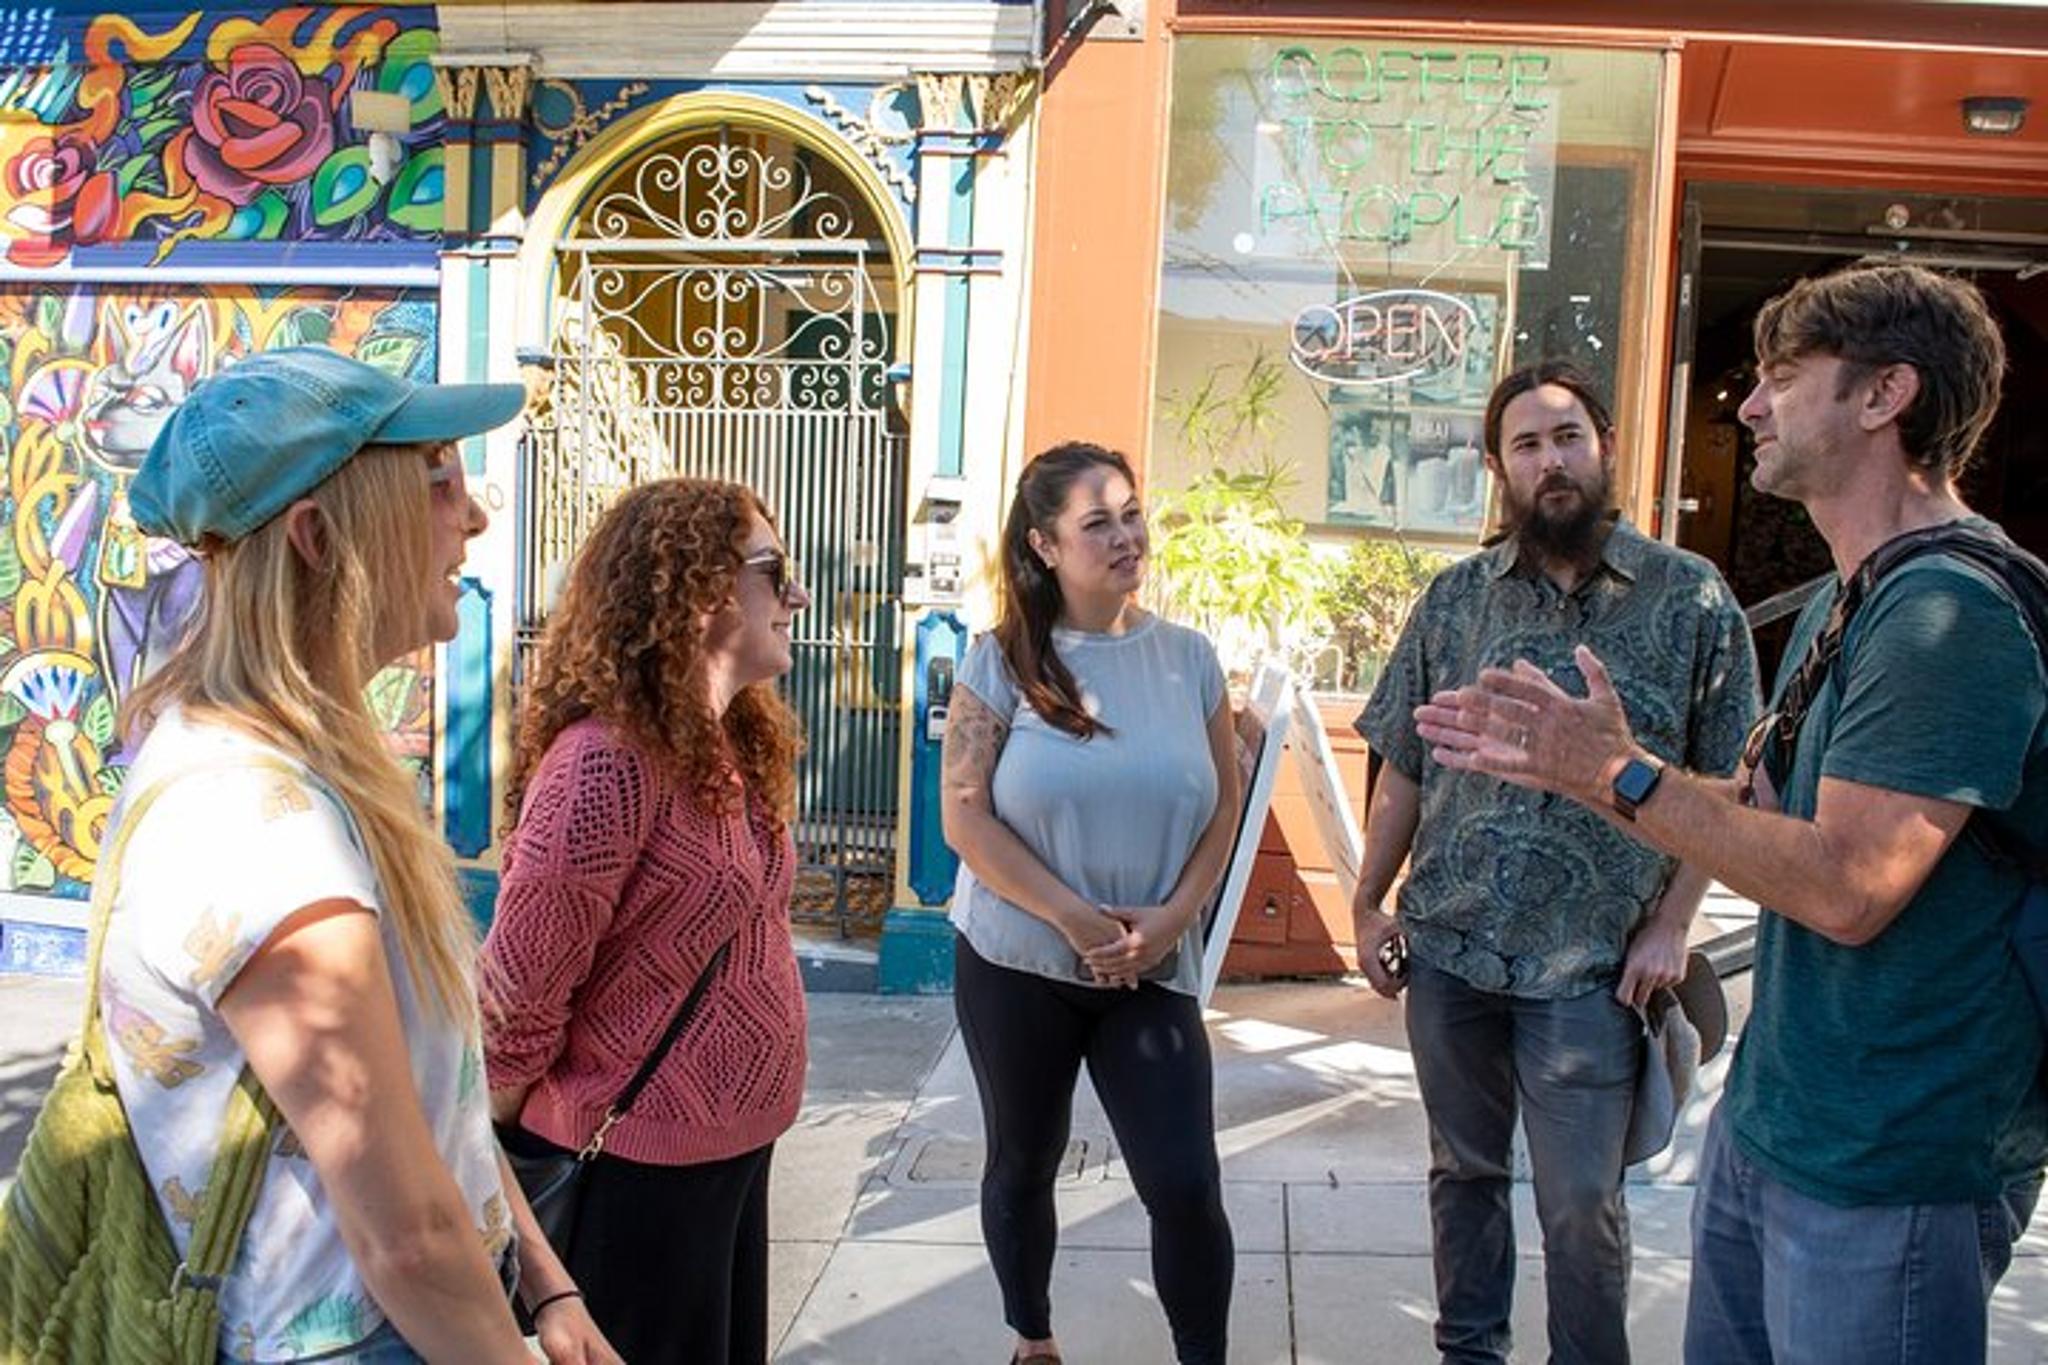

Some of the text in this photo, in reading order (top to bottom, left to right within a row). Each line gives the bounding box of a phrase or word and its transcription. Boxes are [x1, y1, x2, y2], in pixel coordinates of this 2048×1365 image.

[1273, 47, 1549, 108] COFFEE
[1281, 115, 1532, 183] TO THE
[1260, 182, 1540, 249] PEOPLE
[1291, 303, 1463, 359] OPEN
